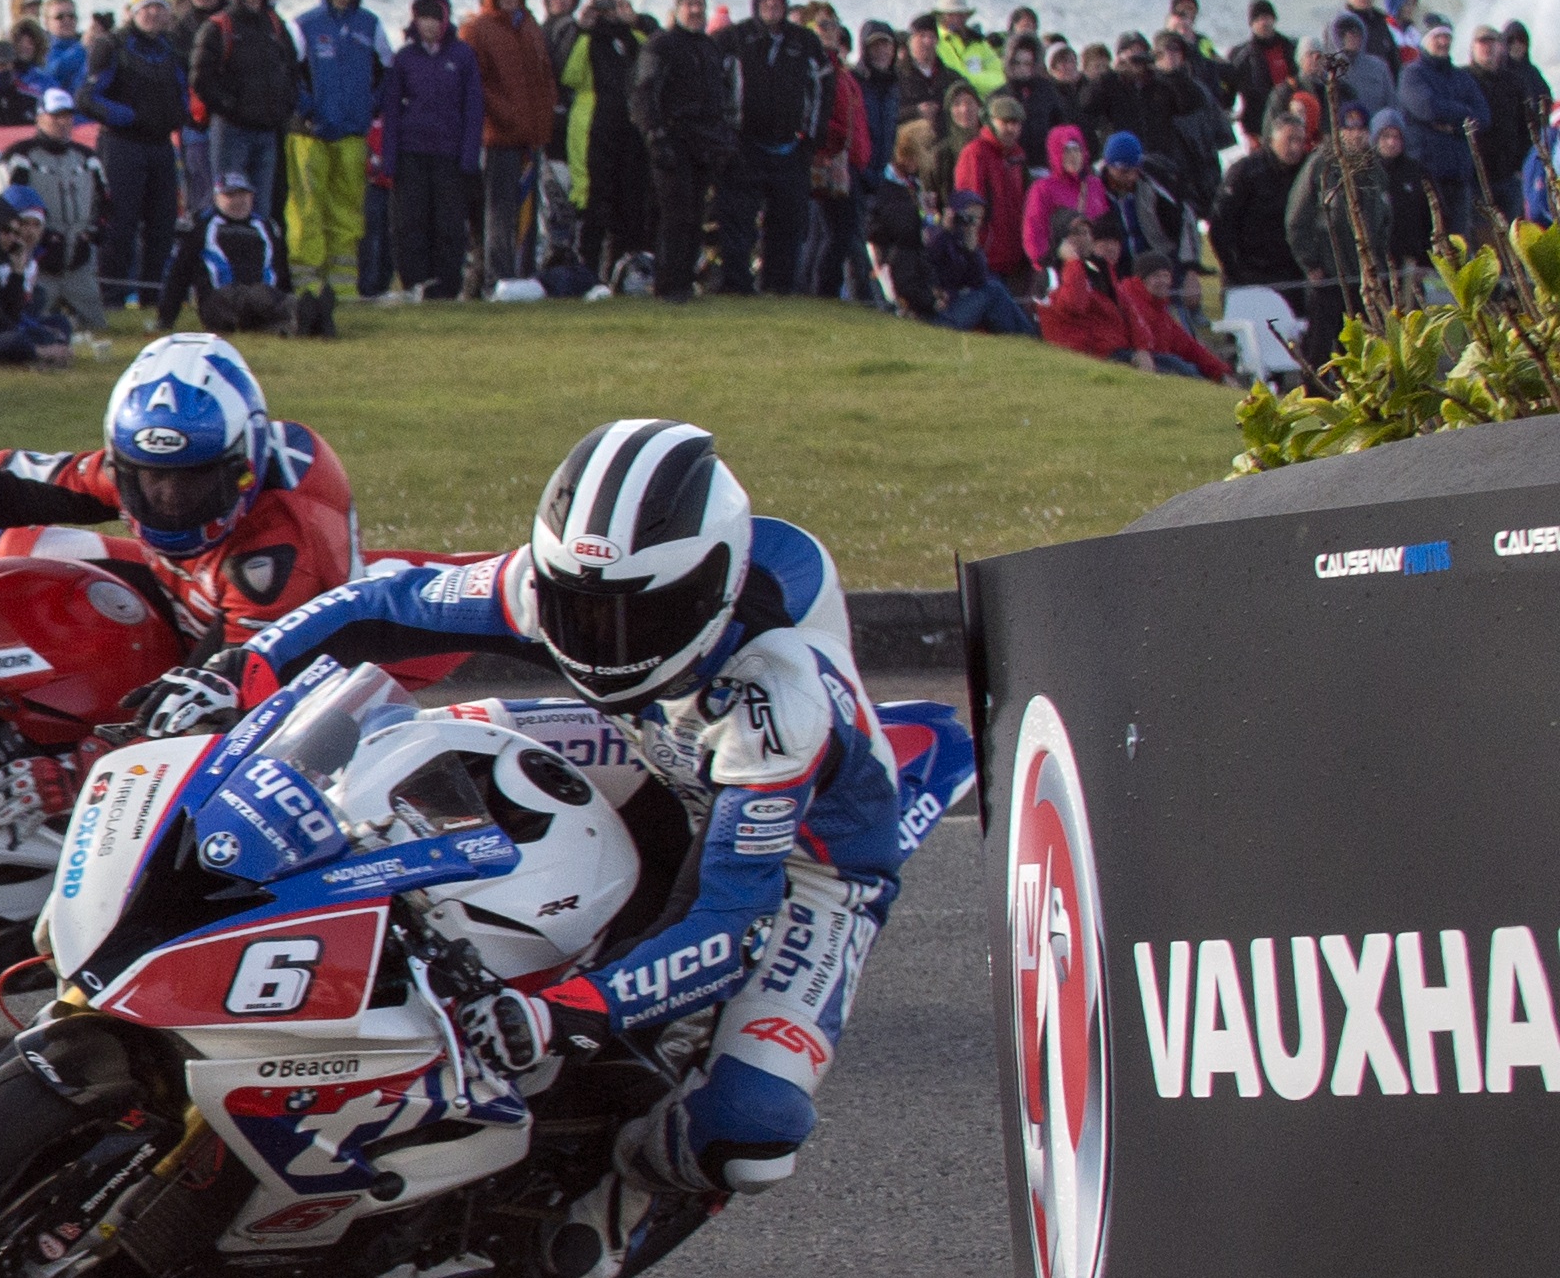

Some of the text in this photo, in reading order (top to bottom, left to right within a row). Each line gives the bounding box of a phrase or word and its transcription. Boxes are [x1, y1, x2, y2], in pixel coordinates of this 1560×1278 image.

[138, 431, 185, 450] Arai
[574, 541, 614, 561] BELL
[219, 789, 290, 854] METZELER
[245, 757, 334, 844] tyco
[899, 791, 943, 851] yco
[62, 806, 102, 900] OXFORD
[228, 939, 321, 1016] 6
[607, 931, 733, 1006] tyco
[759, 901, 815, 994] tyco
[800, 970, 826, 1009] BMW
[1133, 925, 1560, 1102] VAUXHA
[281, 1055, 362, 1080] Beacon
